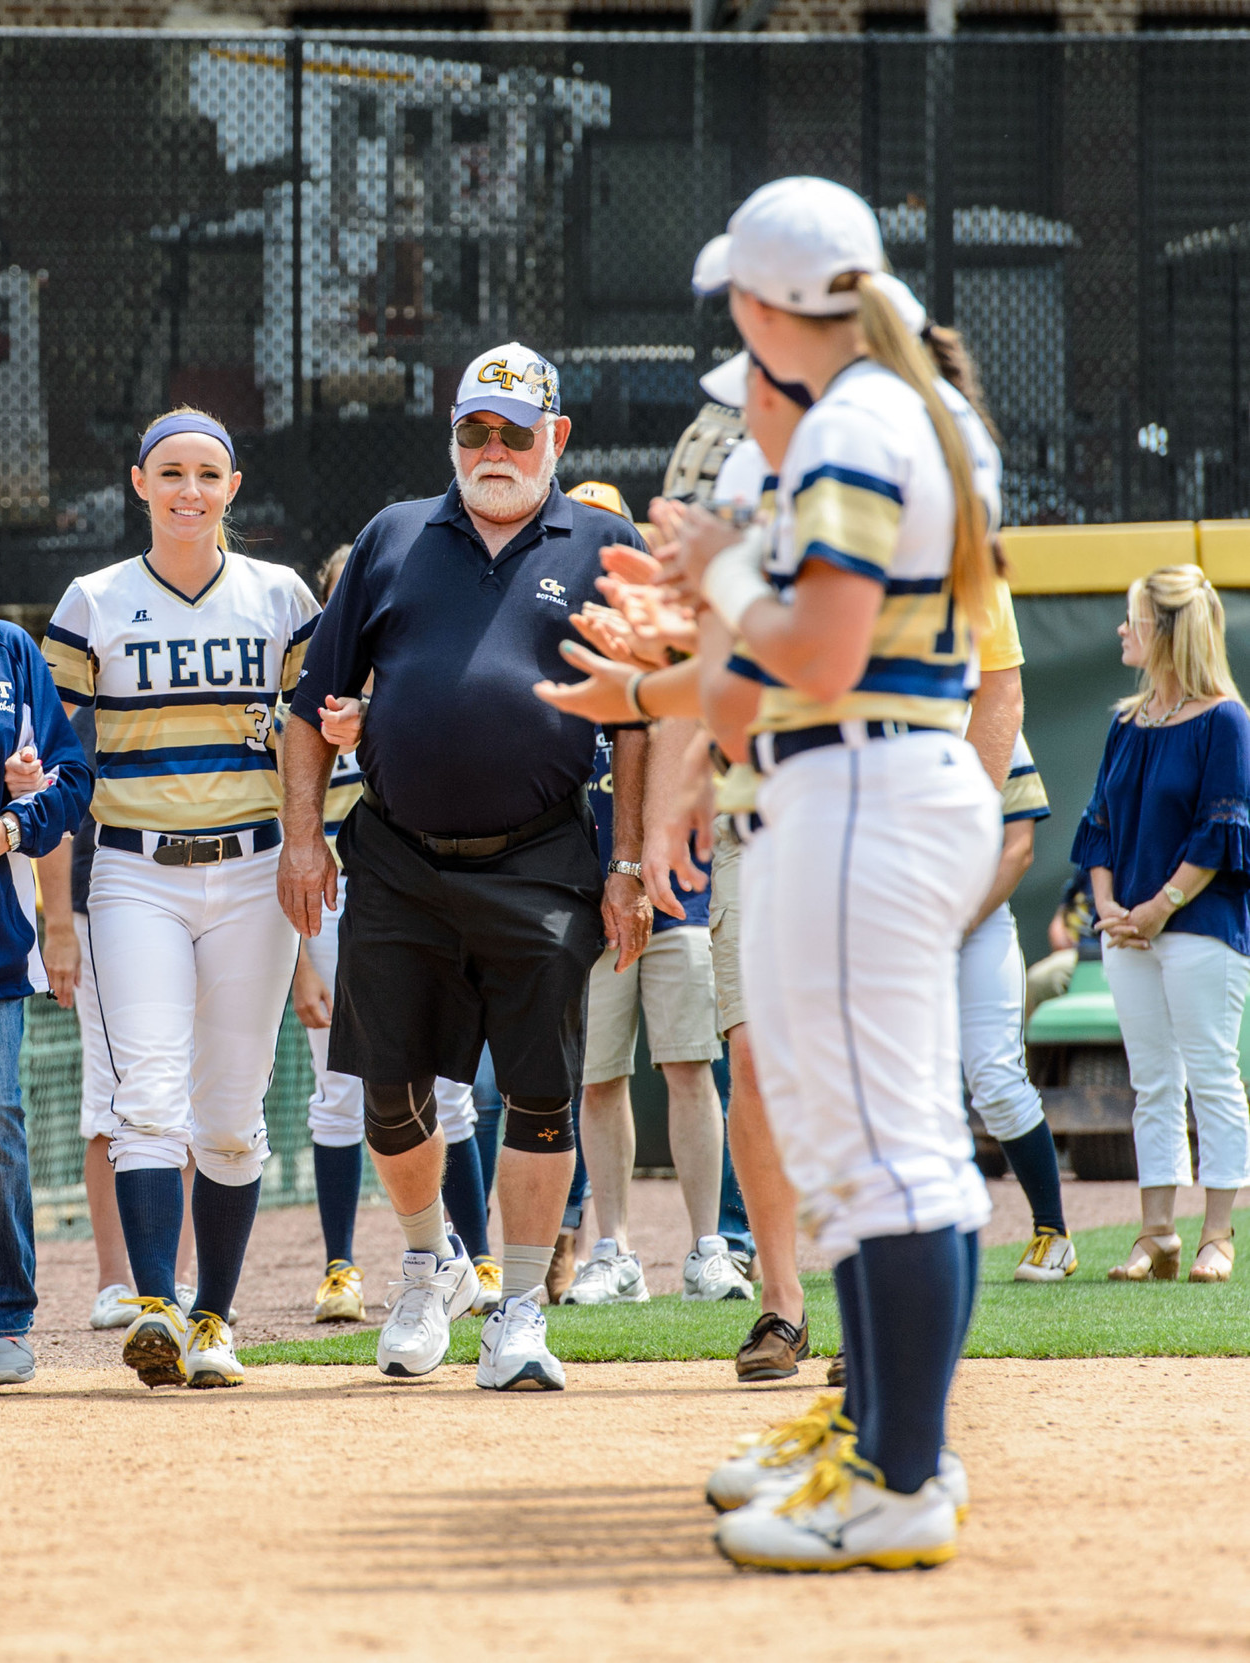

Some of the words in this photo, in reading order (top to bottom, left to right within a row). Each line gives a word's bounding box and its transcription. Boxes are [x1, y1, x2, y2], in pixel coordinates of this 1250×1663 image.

[477, 359, 524, 391] GT
[540, 578, 566, 597] GT
[124, 637, 267, 691] TECH
[244, 702, 272, 751] 3
